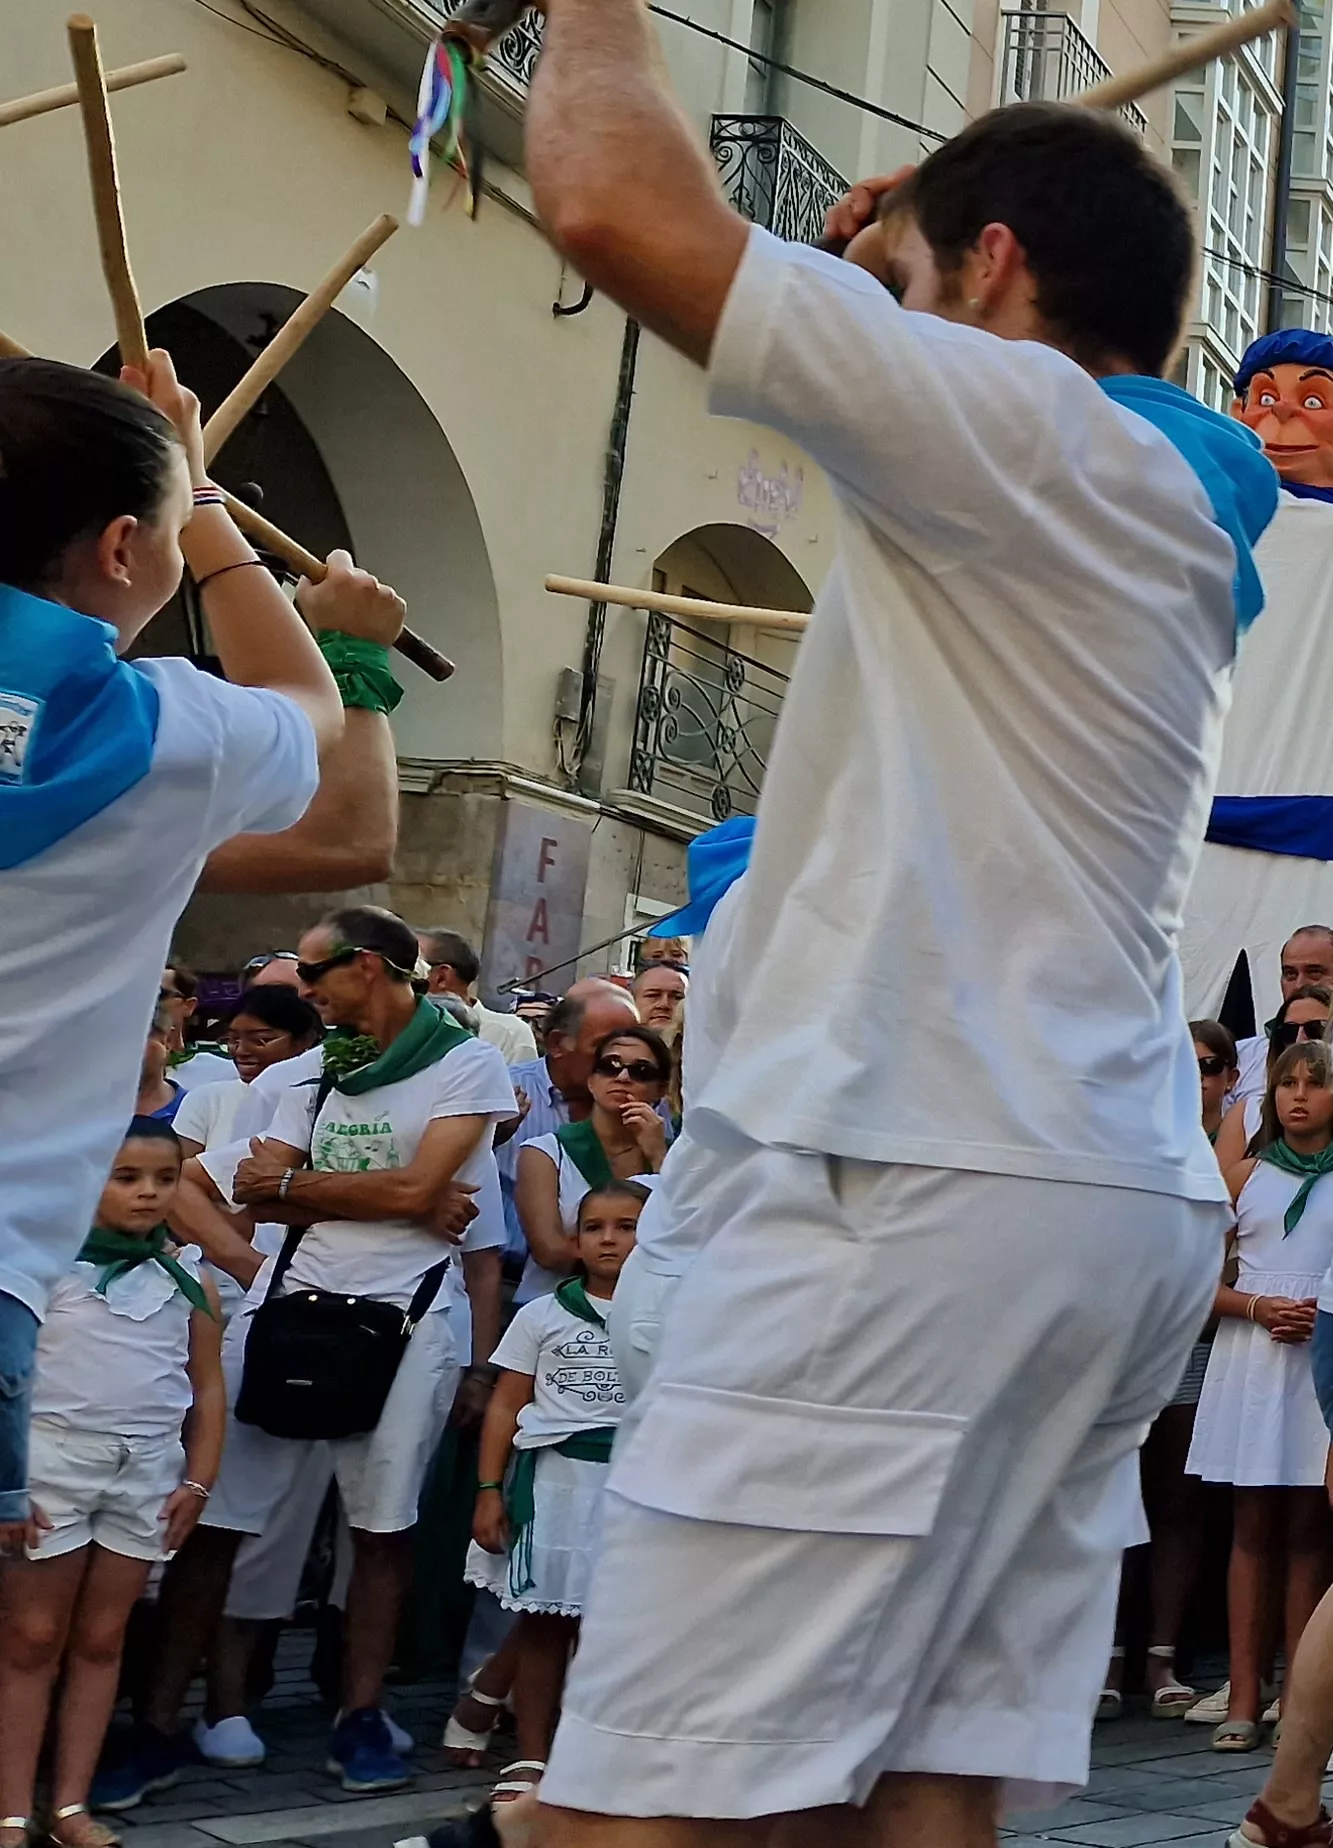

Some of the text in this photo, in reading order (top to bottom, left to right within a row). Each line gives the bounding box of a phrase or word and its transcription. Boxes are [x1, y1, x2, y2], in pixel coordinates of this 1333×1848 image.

[565, 1345, 613, 1355] LA R
[558, 1371, 578, 1384] DE
